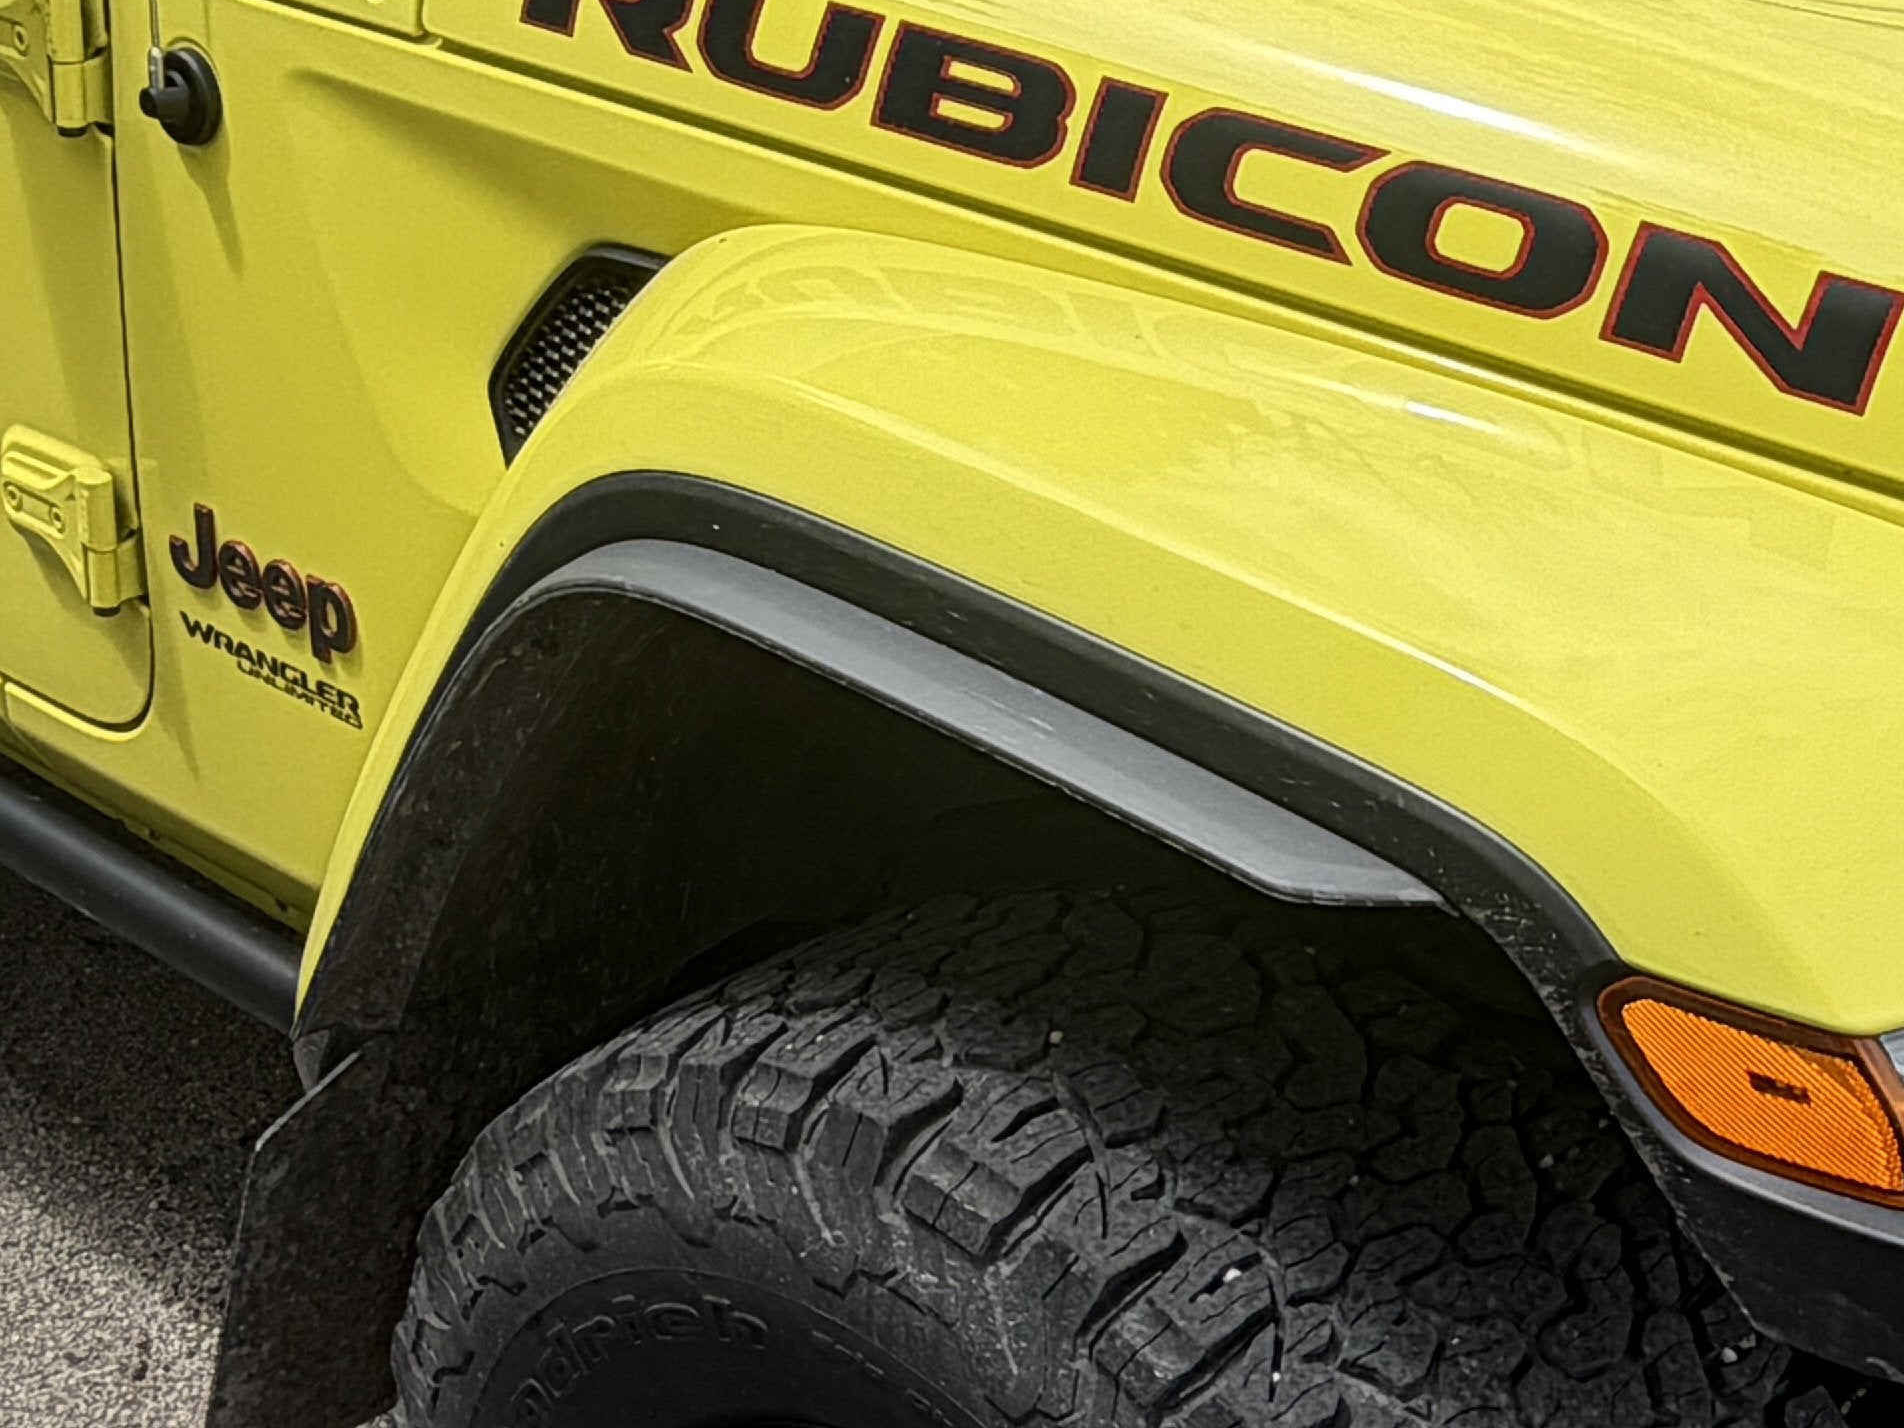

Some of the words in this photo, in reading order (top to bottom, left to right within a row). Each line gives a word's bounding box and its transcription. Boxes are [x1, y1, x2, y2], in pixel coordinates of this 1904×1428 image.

[168, 502, 359, 665] Jeep
[179, 609, 361, 714] WRANGLER
[235, 657, 364, 731] UNLIMITED
